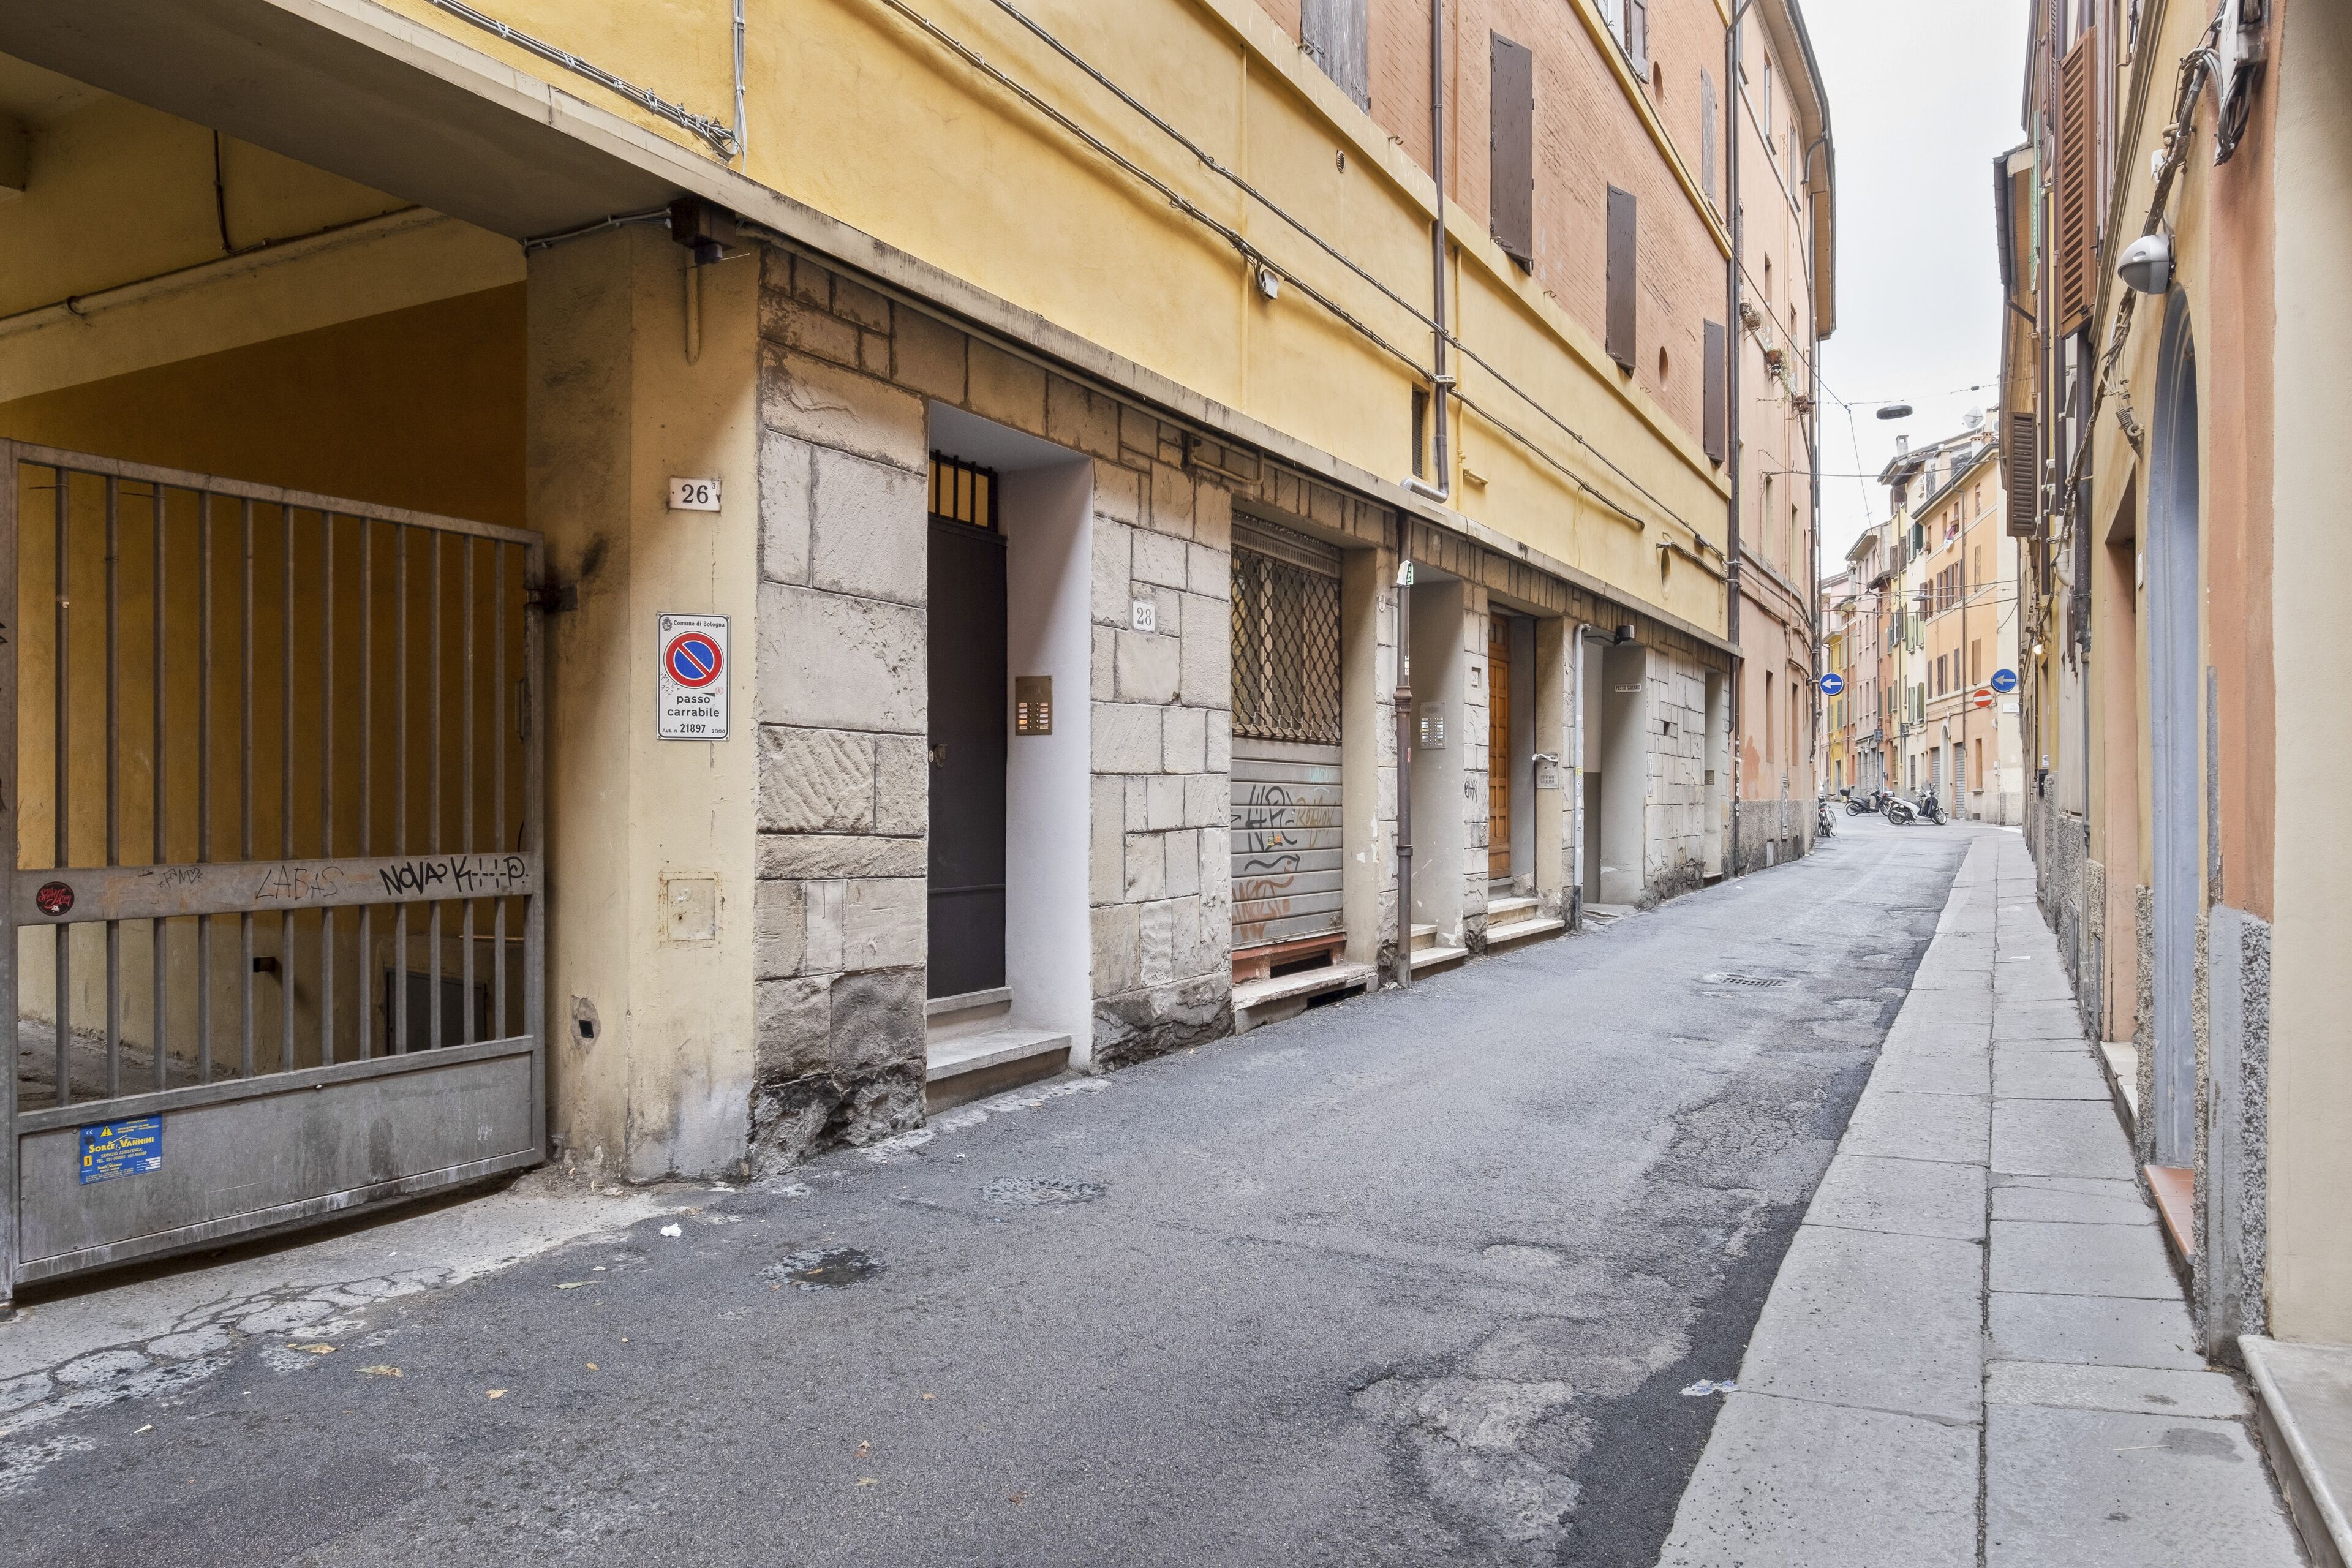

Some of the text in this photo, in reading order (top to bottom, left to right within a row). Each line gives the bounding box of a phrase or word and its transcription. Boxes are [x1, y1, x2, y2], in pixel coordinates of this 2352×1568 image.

[682, 484, 709, 504] 26
[1137, 607, 1152, 626] 28
[677, 696, 710, 705] passo
[667, 707, 720, 717] carrabile
[680, 723, 706, 734] 21897
[119, 1137, 154, 1148] VANNINI
